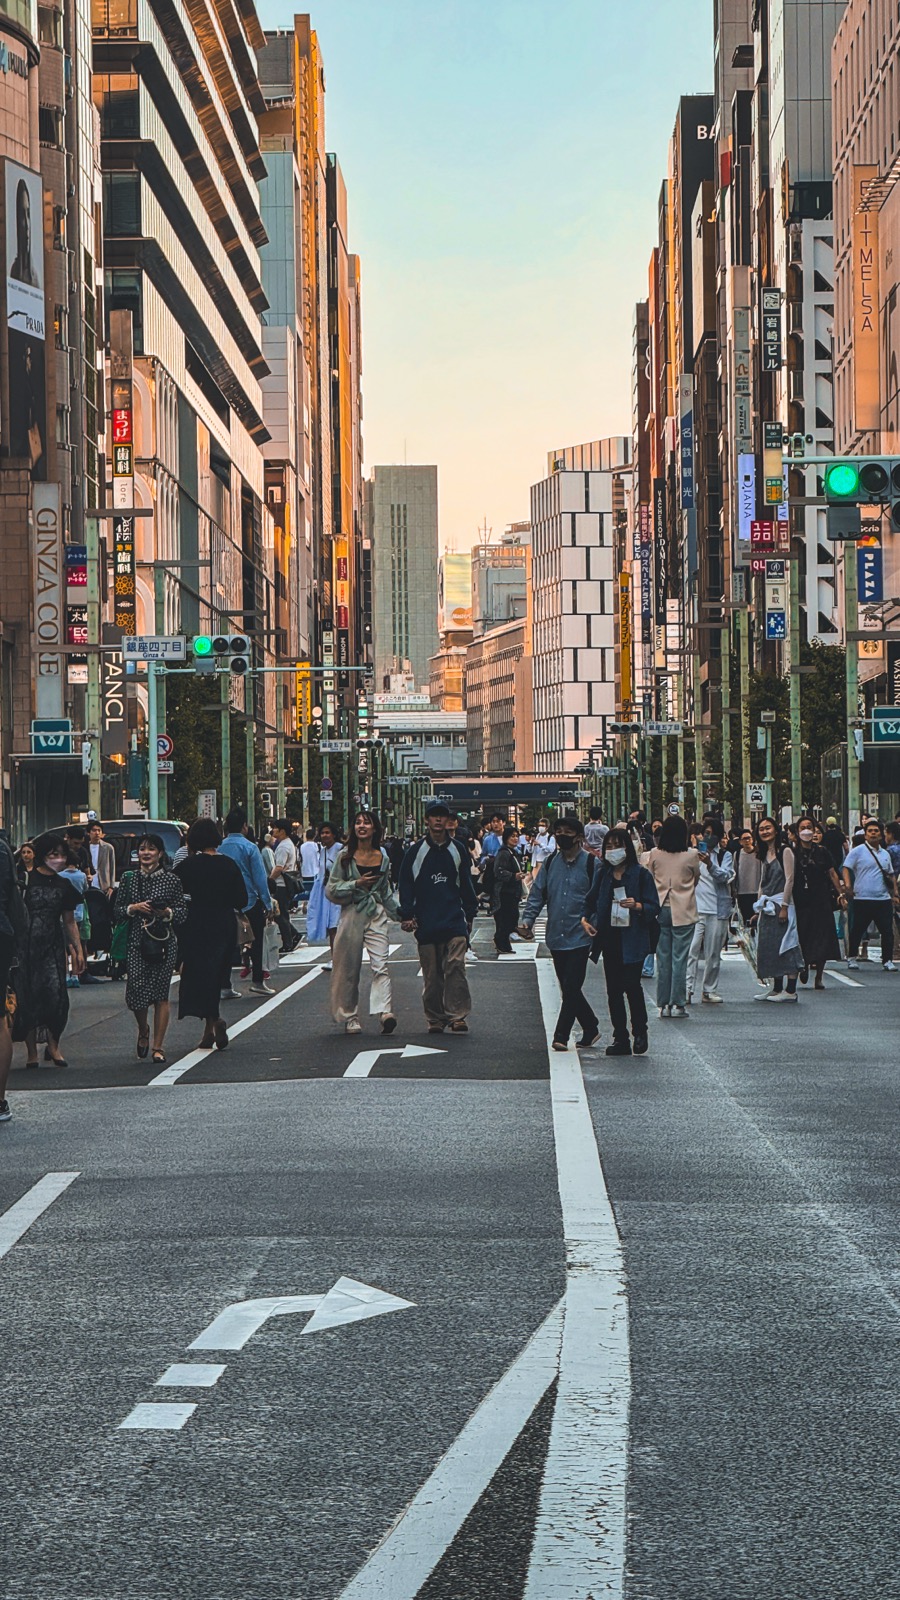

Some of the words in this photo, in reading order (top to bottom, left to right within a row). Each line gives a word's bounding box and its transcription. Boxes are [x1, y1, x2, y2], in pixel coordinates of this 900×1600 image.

[26, 316, 44, 335] PRADA
[766, 317, 778, 369] 岩崎ビル
[116, 410, 129, 437] まつげ
[117, 447, 129, 474] 歯科
[681, 427, 693, 497] 名鉄観光
[743, 480, 754, 519] DIANA
[36, 508, 58, 594] GINZA
[117, 551, 131, 574] 歯科
[864, 553, 875, 597] PLAZA
[772, 588, 780, 604] 買取
[126, 641, 182, 652] 銀座四丁目
[105, 651, 124, 731] FANCL
